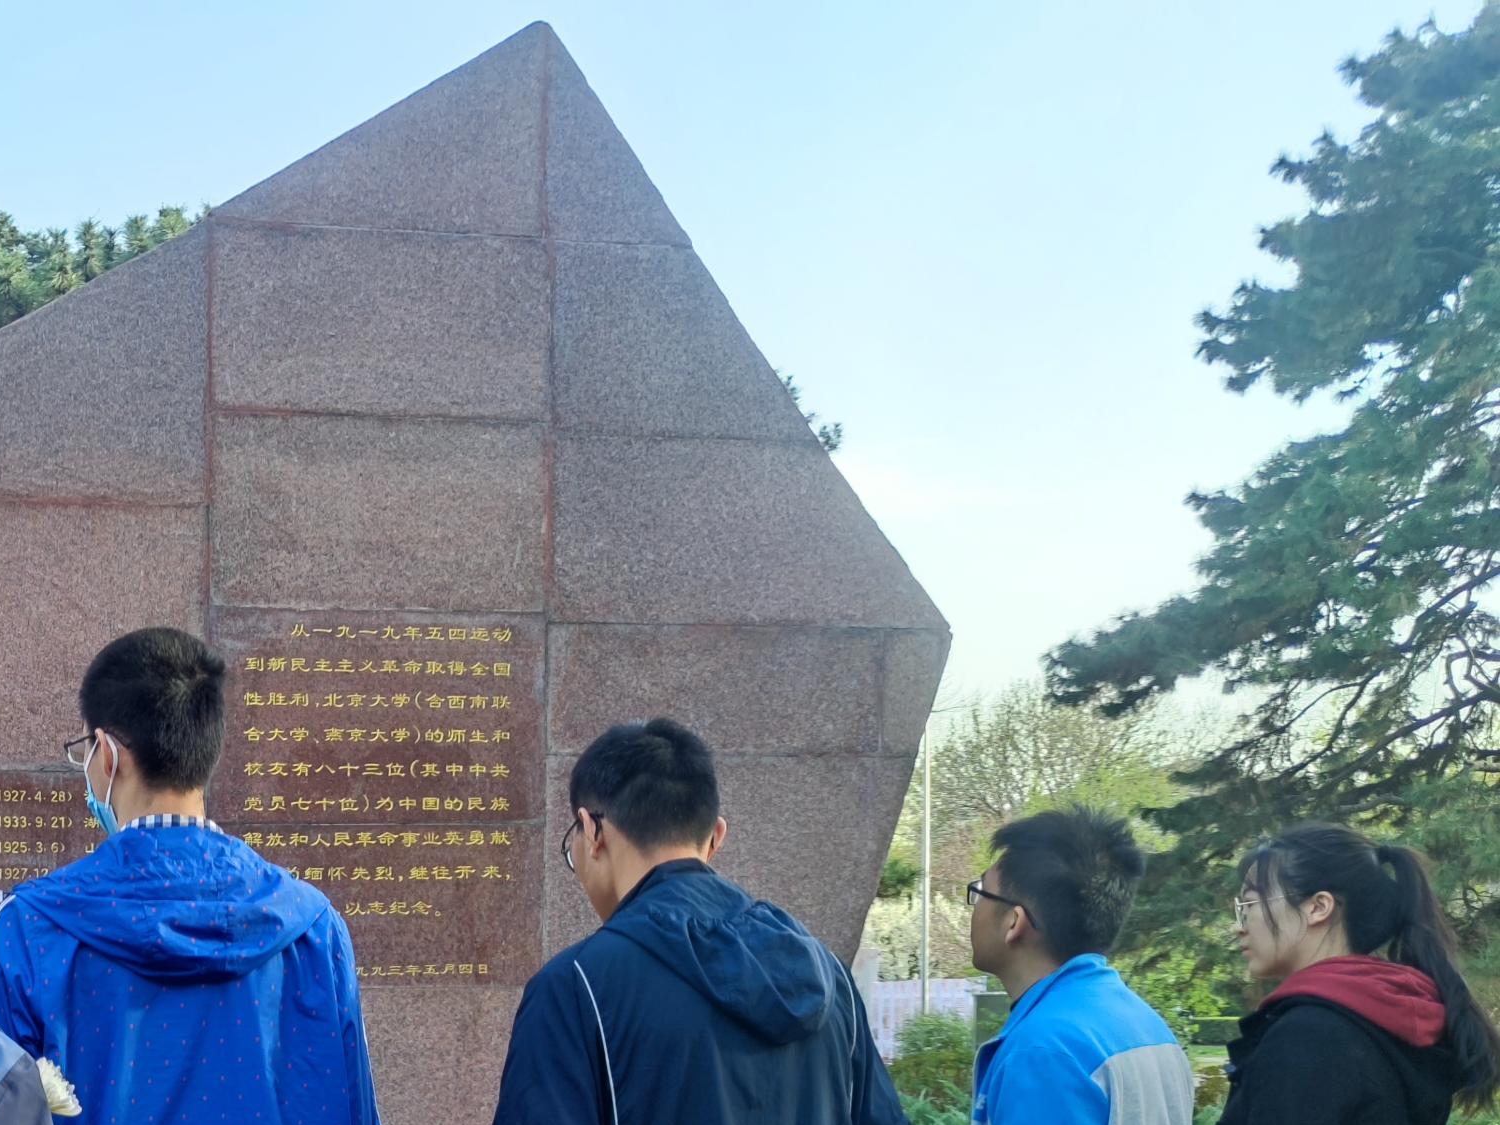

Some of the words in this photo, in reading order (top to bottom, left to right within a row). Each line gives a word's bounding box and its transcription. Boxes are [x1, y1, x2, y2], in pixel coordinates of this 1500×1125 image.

[291, 623, 512, 642] 从一九一九年五四运动
[245, 656, 511, 677] 到新民主主义革命取得全国
[244, 794, 511, 812] 党员七十位）为中国的民族
[244, 830, 511, 848] 解放和人民革命事业英勇献
[344, 901, 443, 918] 以志纪念。
